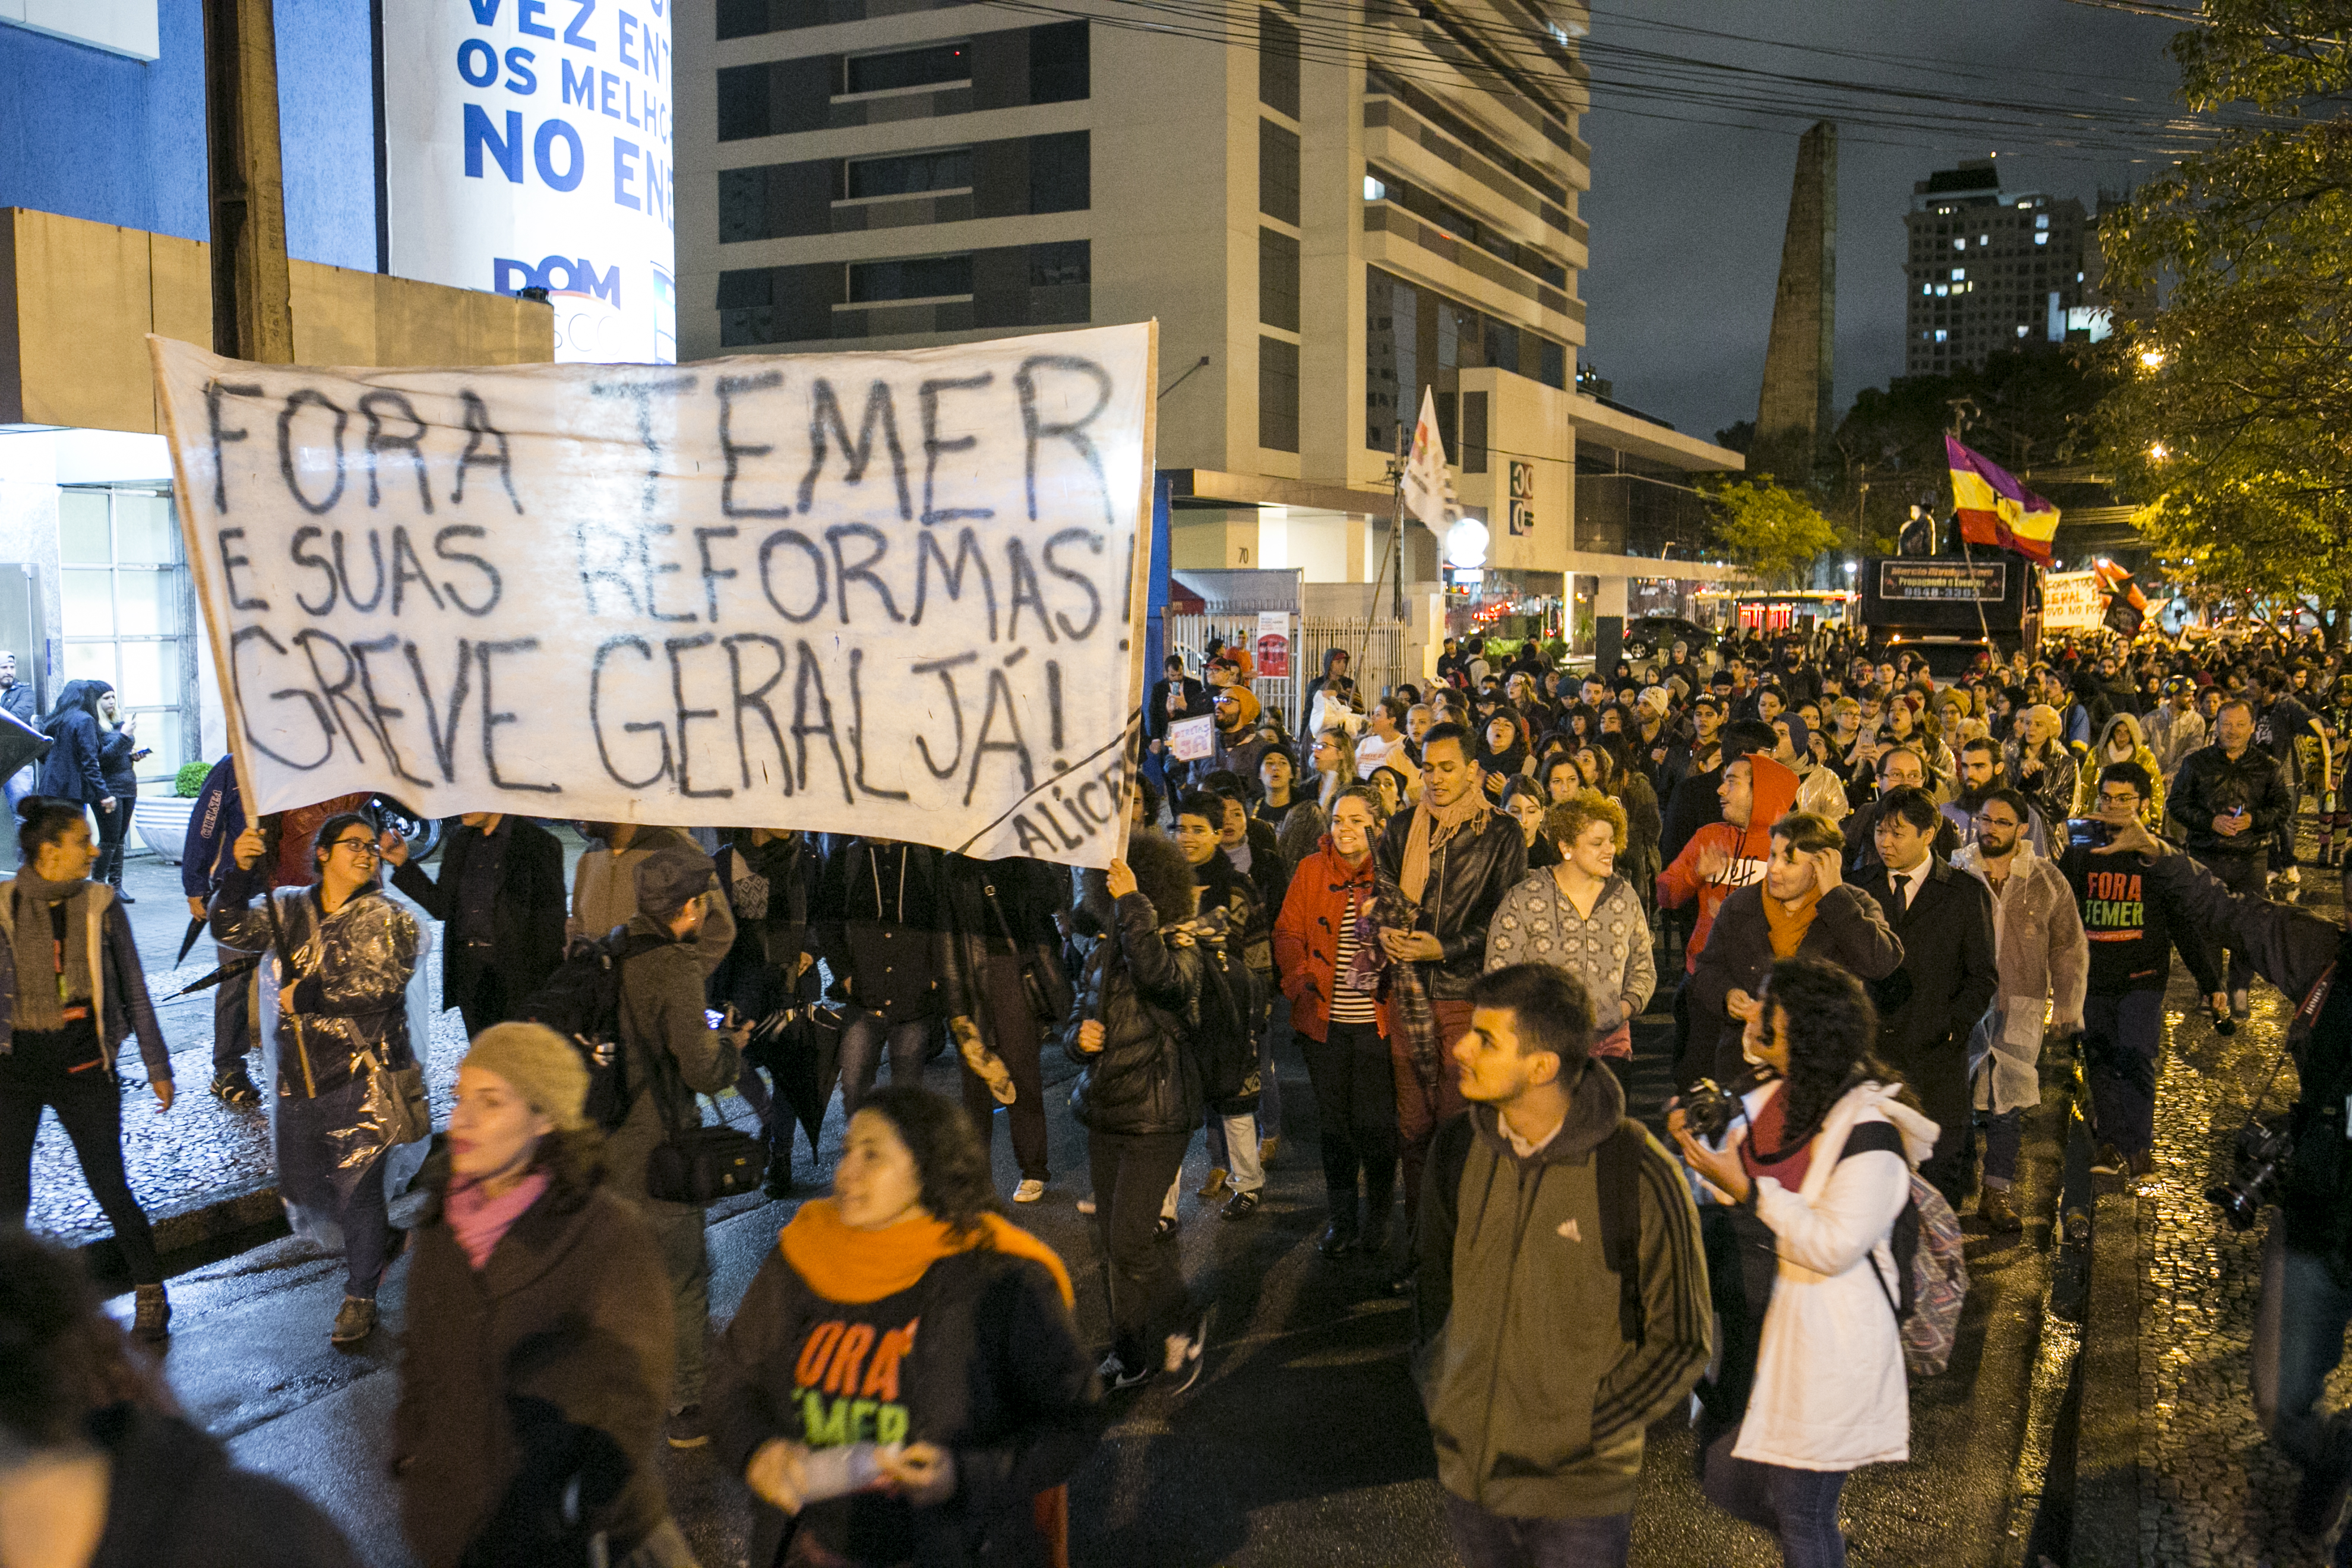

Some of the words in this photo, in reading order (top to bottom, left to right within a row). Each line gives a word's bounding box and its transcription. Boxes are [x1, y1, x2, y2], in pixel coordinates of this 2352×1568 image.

[457, 38, 537, 96] OS
[561, 58, 672, 145] MELHO
[463, 102, 584, 192] NO
[494, 254, 621, 311] DOM
[204, 380, 525, 516] FORA
[591, 355, 1115, 525] TEMER
[218, 527, 270, 611] E
[291, 524, 502, 617] SUAS
[1238, 547, 1249, 564] 70
[1899, 577, 1947, 587] Propaganda
[2044, 606, 2063, 616] OVO
[231, 624, 561, 794] GREVE
[590, 632, 909, 805] GERAL
[911, 646, 1070, 807] JÁ!
[2085, 899, 2144, 927] TEMER
[2088, 871, 2142, 902] FORA
